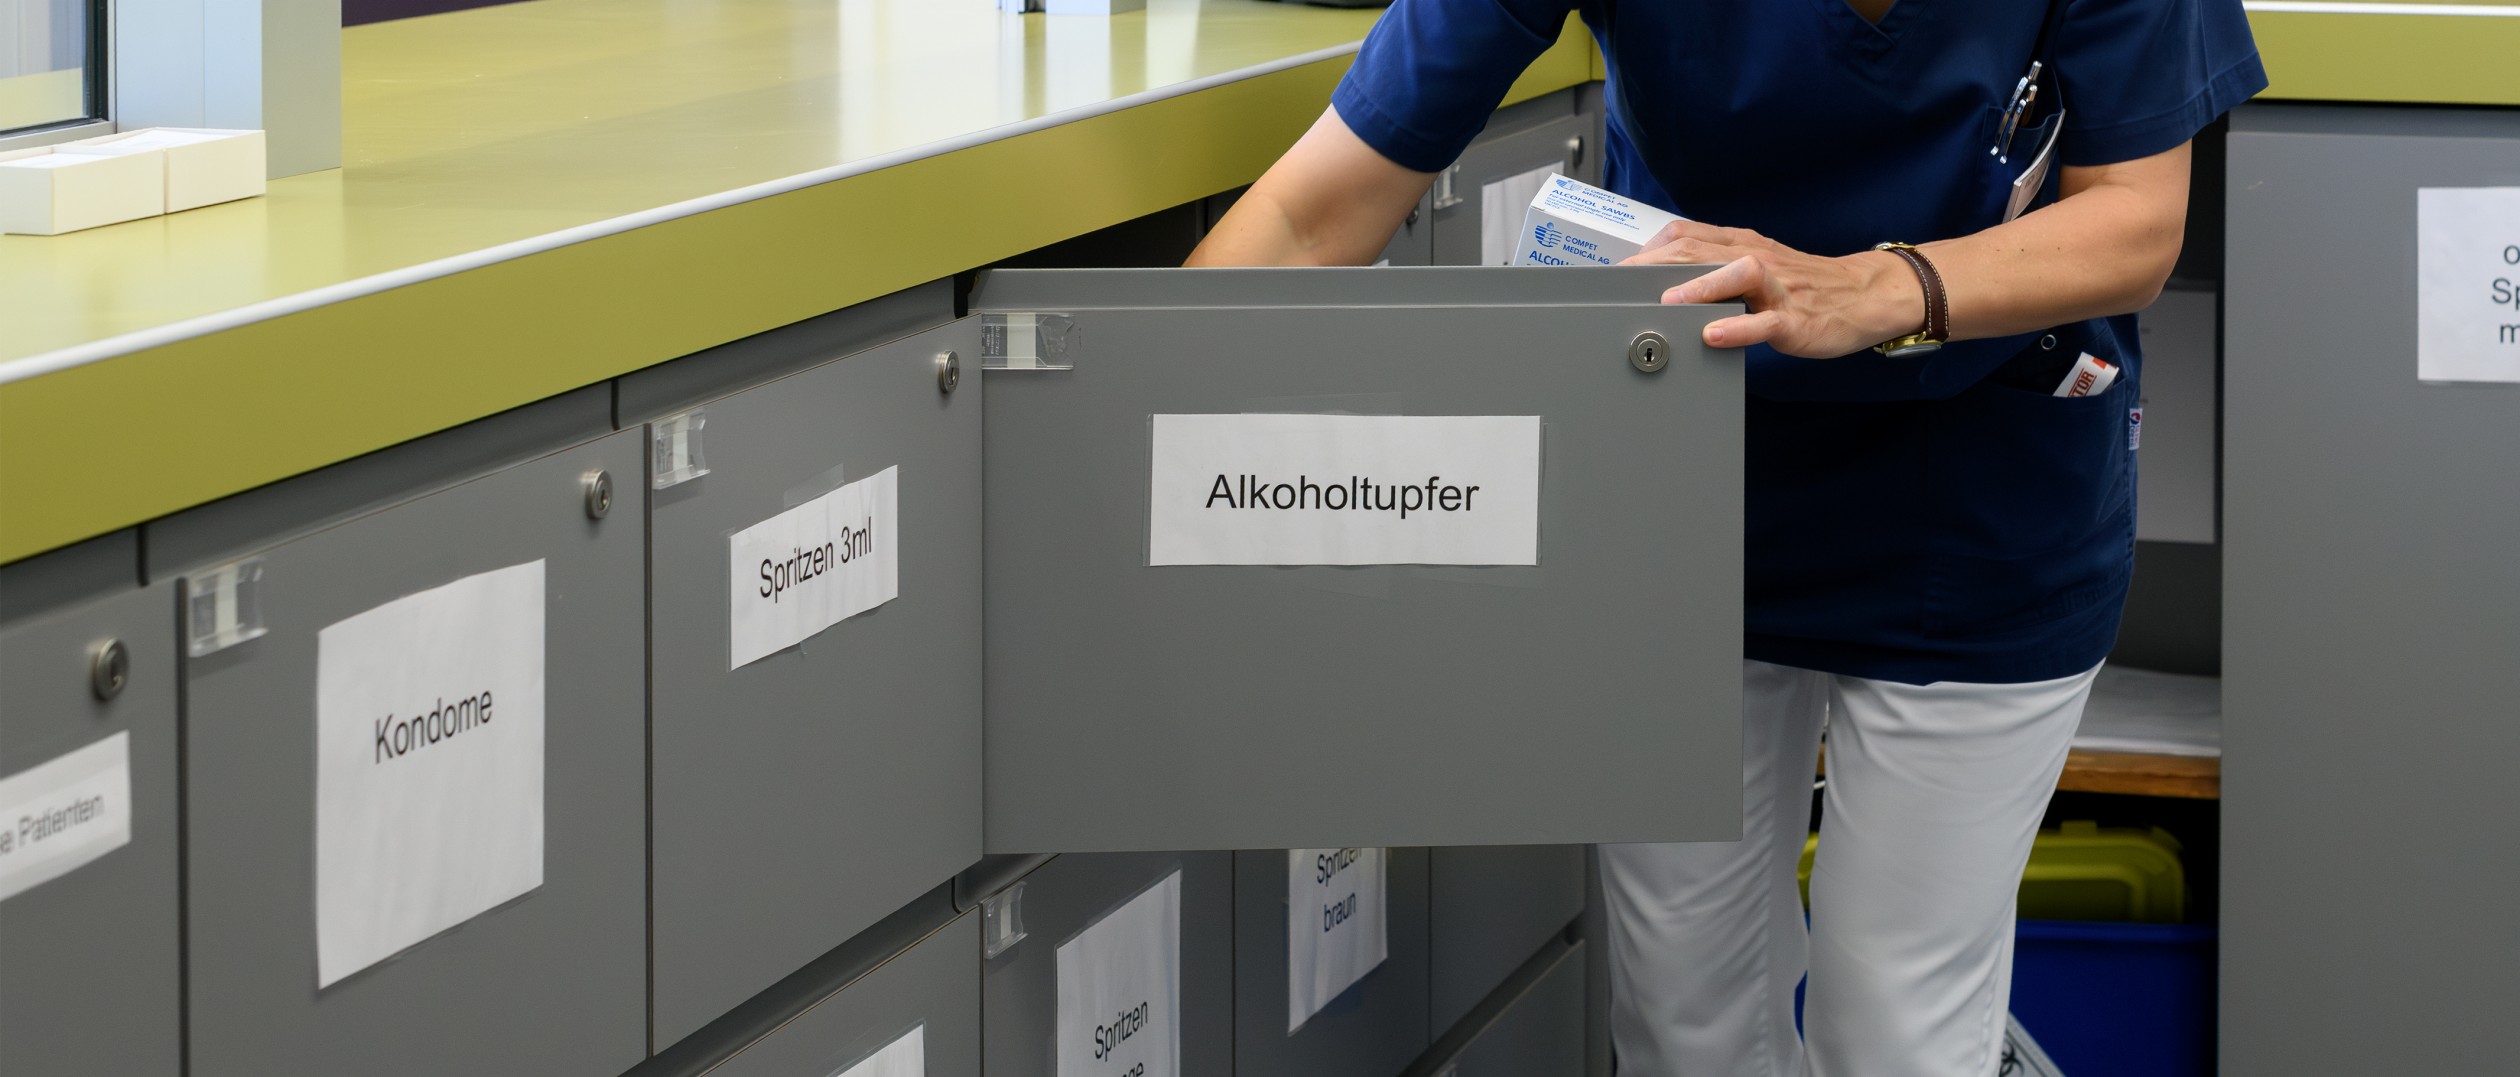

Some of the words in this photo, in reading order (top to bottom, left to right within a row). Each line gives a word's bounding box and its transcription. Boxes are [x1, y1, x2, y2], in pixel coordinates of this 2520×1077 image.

[1552, 189, 1597, 208] ALCOHOL
[1601, 205, 1636, 220] SAWBS
[1582, 190, 1614, 204] MEDICAL
[1584, 187, 1616, 200] COMPET
[1562, 244, 1597, 261] MEDICAL
[1597, 256, 1610, 265] AG
[1565, 235, 1598, 251] COMPET
[1205, 474, 1480, 520] Alkoholtupfer
[760, 541, 834, 604] Spritzen
[841, 516, 872, 564] 3ml
[375, 690, 493, 765] Kondome
[18, 793, 105, 849] Patienten
[1324, 892, 1356, 933] braun
[1094, 1001, 1149, 1062] Spritzen
